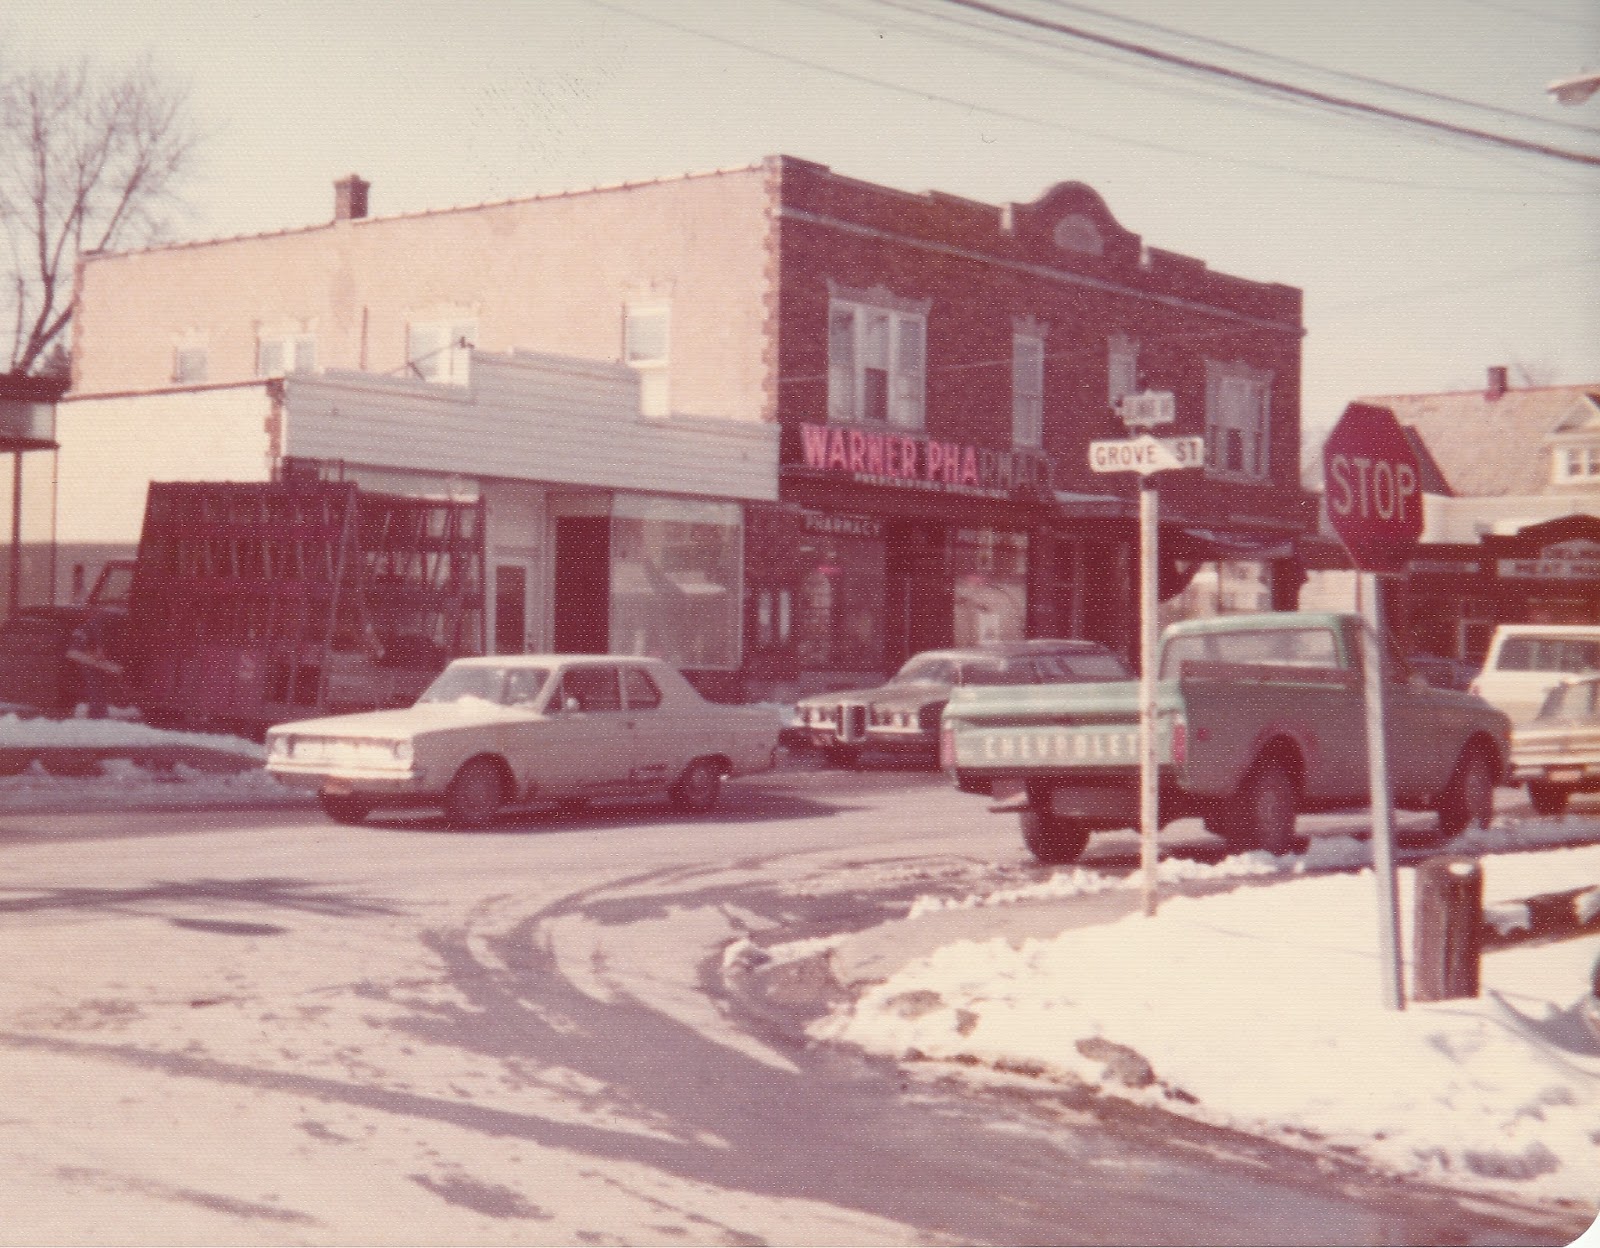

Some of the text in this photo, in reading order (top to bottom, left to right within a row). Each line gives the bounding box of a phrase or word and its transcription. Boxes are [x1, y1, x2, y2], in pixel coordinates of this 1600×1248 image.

[800, 424, 918, 477] WARNER
[1095, 440, 1199, 466] GROVE ST
[1330, 454, 1416, 521] STOP
[805, 515, 881, 537] PHARMACY
[984, 734, 1138, 759] CHEVROLET
